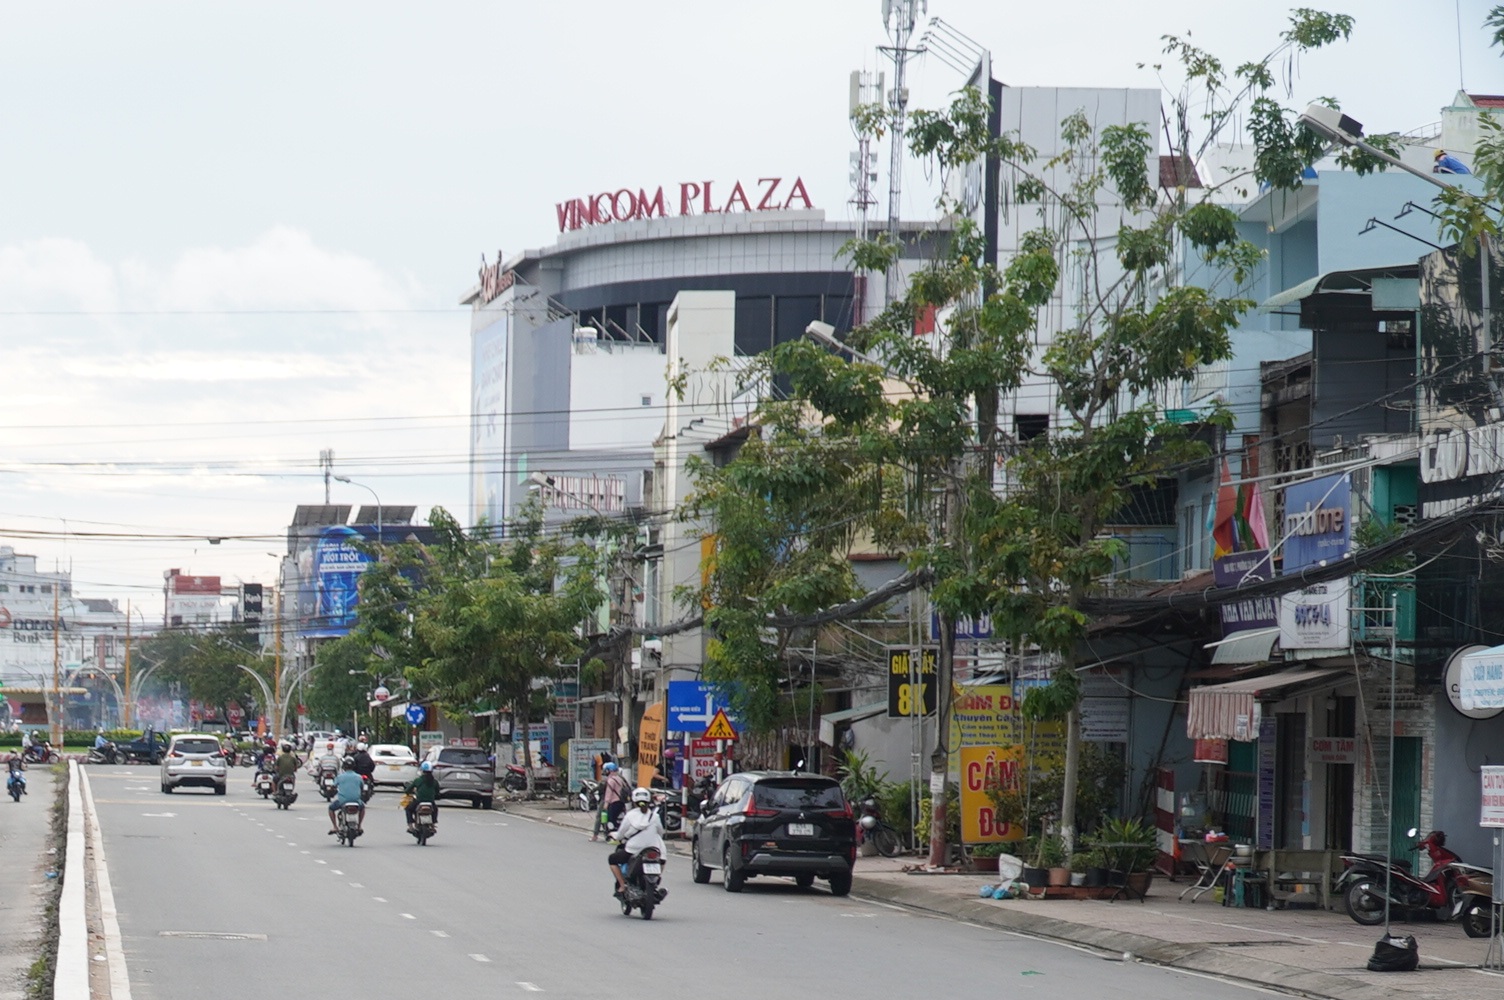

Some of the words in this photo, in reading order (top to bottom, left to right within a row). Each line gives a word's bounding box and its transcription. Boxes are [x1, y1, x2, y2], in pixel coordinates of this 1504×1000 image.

[556, 185, 666, 234] VINCOM
[679, 176, 816, 216] PLAZA
[12, 632, 41, 644] Bank
[898, 683, 928, 715] 8K
[953, 713, 993, 725] Chuyên
[641, 741, 658, 751] TRANG
[639, 752, 658, 766] NAM
[967, 750, 1021, 792] CẦM
